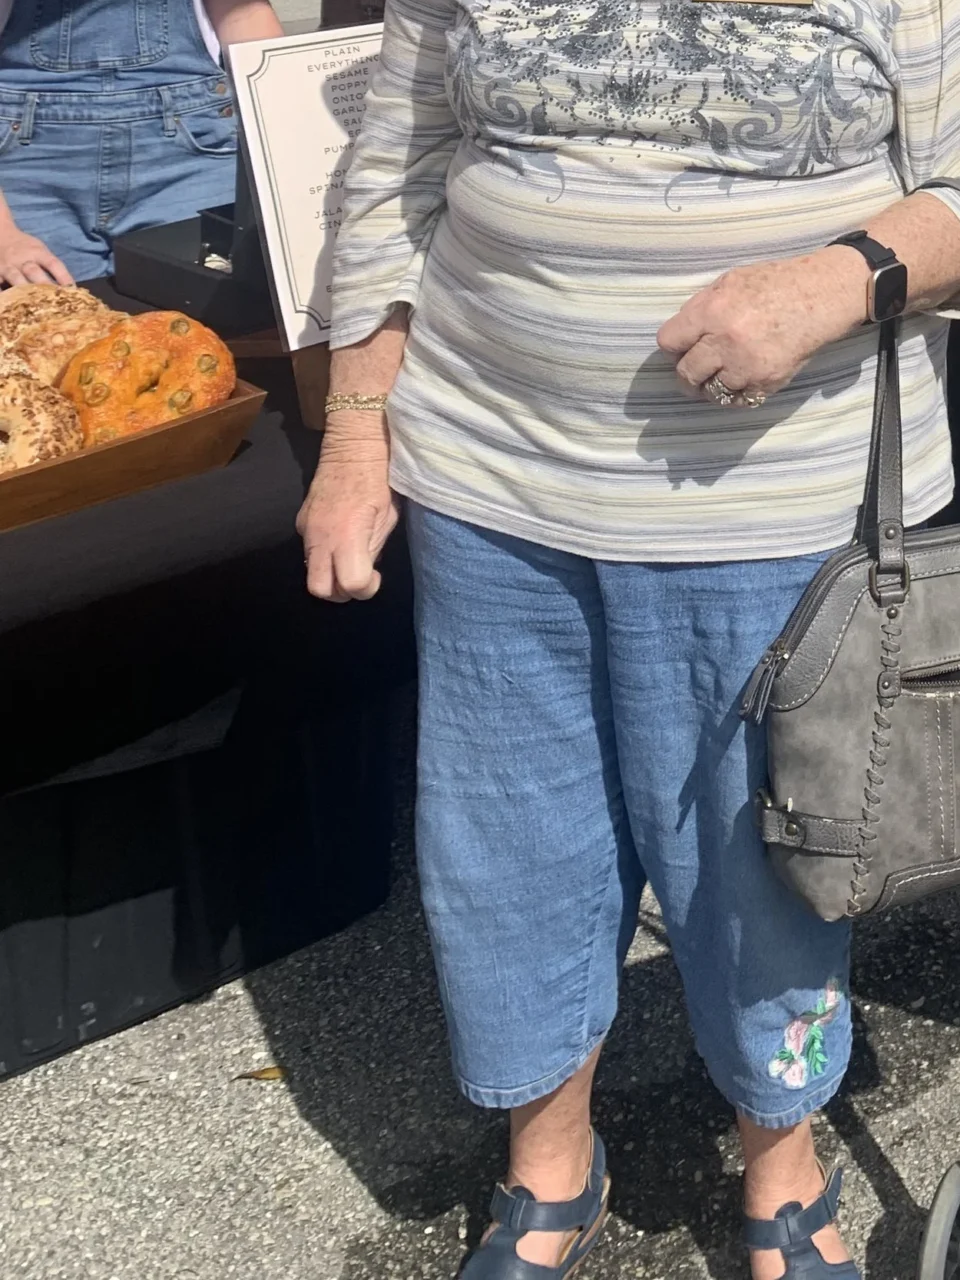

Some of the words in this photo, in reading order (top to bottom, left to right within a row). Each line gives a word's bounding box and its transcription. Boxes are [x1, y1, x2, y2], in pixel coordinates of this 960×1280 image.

[324, 46, 361, 58] PLAIN
[325, 67, 369, 82] SESAME
[331, 80, 368, 93] POPPY
[332, 91, 368, 105] ONIO
[324, 142, 355, 155] PUMP
[308, 180, 345, 195] SPIN
[314, 206, 344, 220] JALA
[318, 219, 342, 231] CIN
